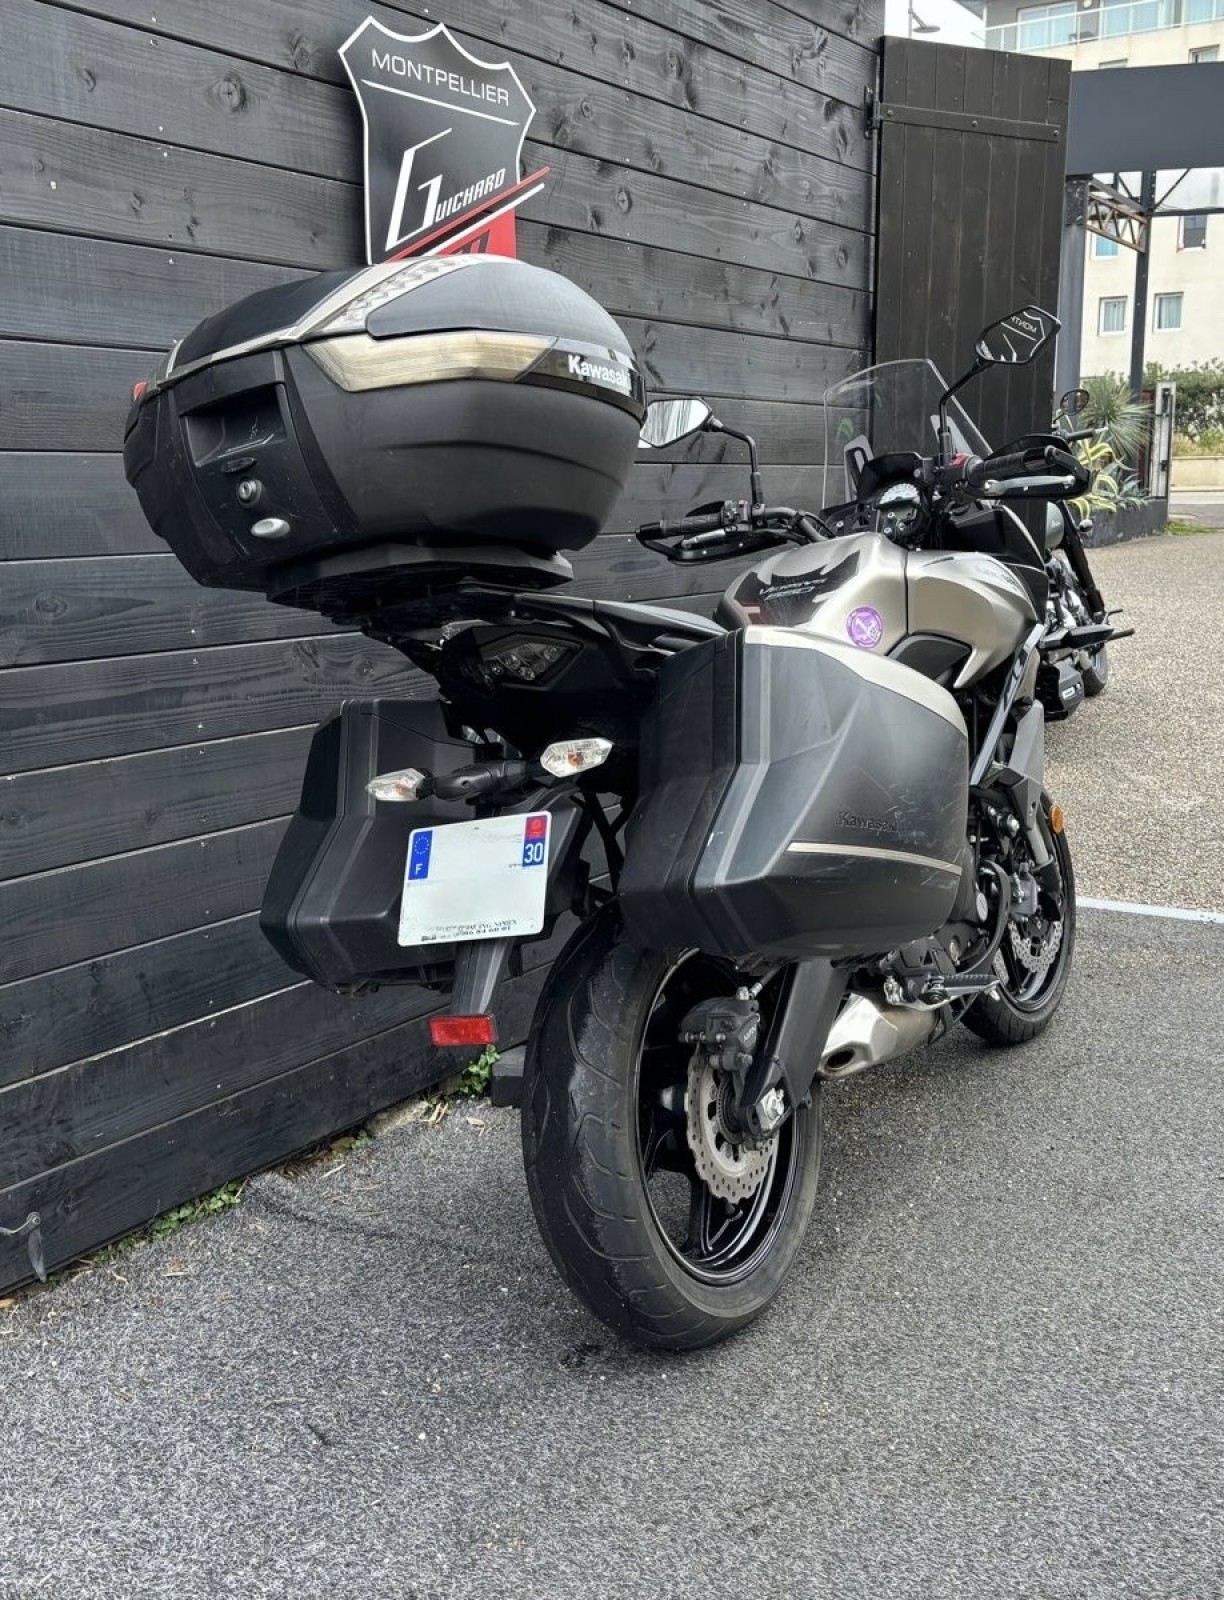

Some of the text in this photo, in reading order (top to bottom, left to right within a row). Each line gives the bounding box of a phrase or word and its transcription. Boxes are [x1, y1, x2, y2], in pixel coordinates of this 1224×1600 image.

[371, 49, 509, 106] MONTPELLIER
[524, 842, 543, 863] 30
[415, 863, 423, 875] F
